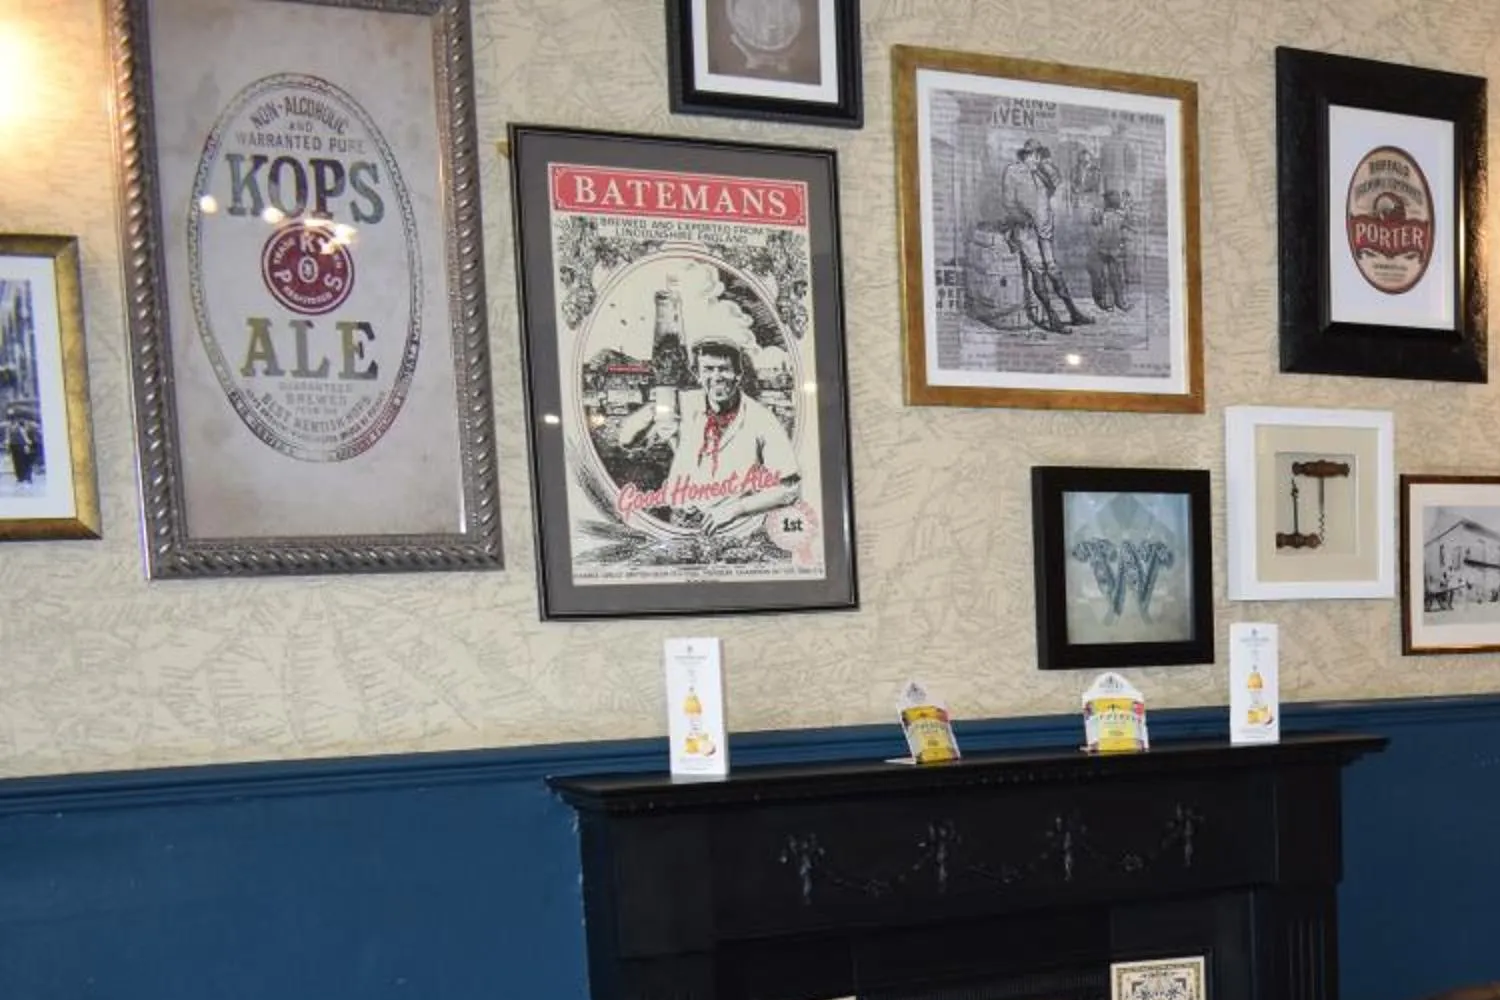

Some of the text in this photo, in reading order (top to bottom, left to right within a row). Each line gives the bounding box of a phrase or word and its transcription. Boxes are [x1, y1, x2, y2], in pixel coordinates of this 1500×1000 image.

[251, 96, 349, 134] NON-ALCOHOLIC
[289, 121, 313, 132] AND
[236, 131, 322, 150] WARRANTED
[225, 153, 384, 224] KOPS
[574, 175, 787, 217] BATEMANS
[602, 216, 647, 229] BREWED
[651, 220, 674, 230] AND
[678, 221, 731, 233] EXPORTED
[615, 227, 749, 243] LINCOLNSHIRE ENGLAND
[1355, 222, 1424, 250] PORTER
[240, 317, 379, 380] ALE
[618, 463, 781, 518] Good Honest Ales
[783, 518, 803, 532] 1st
